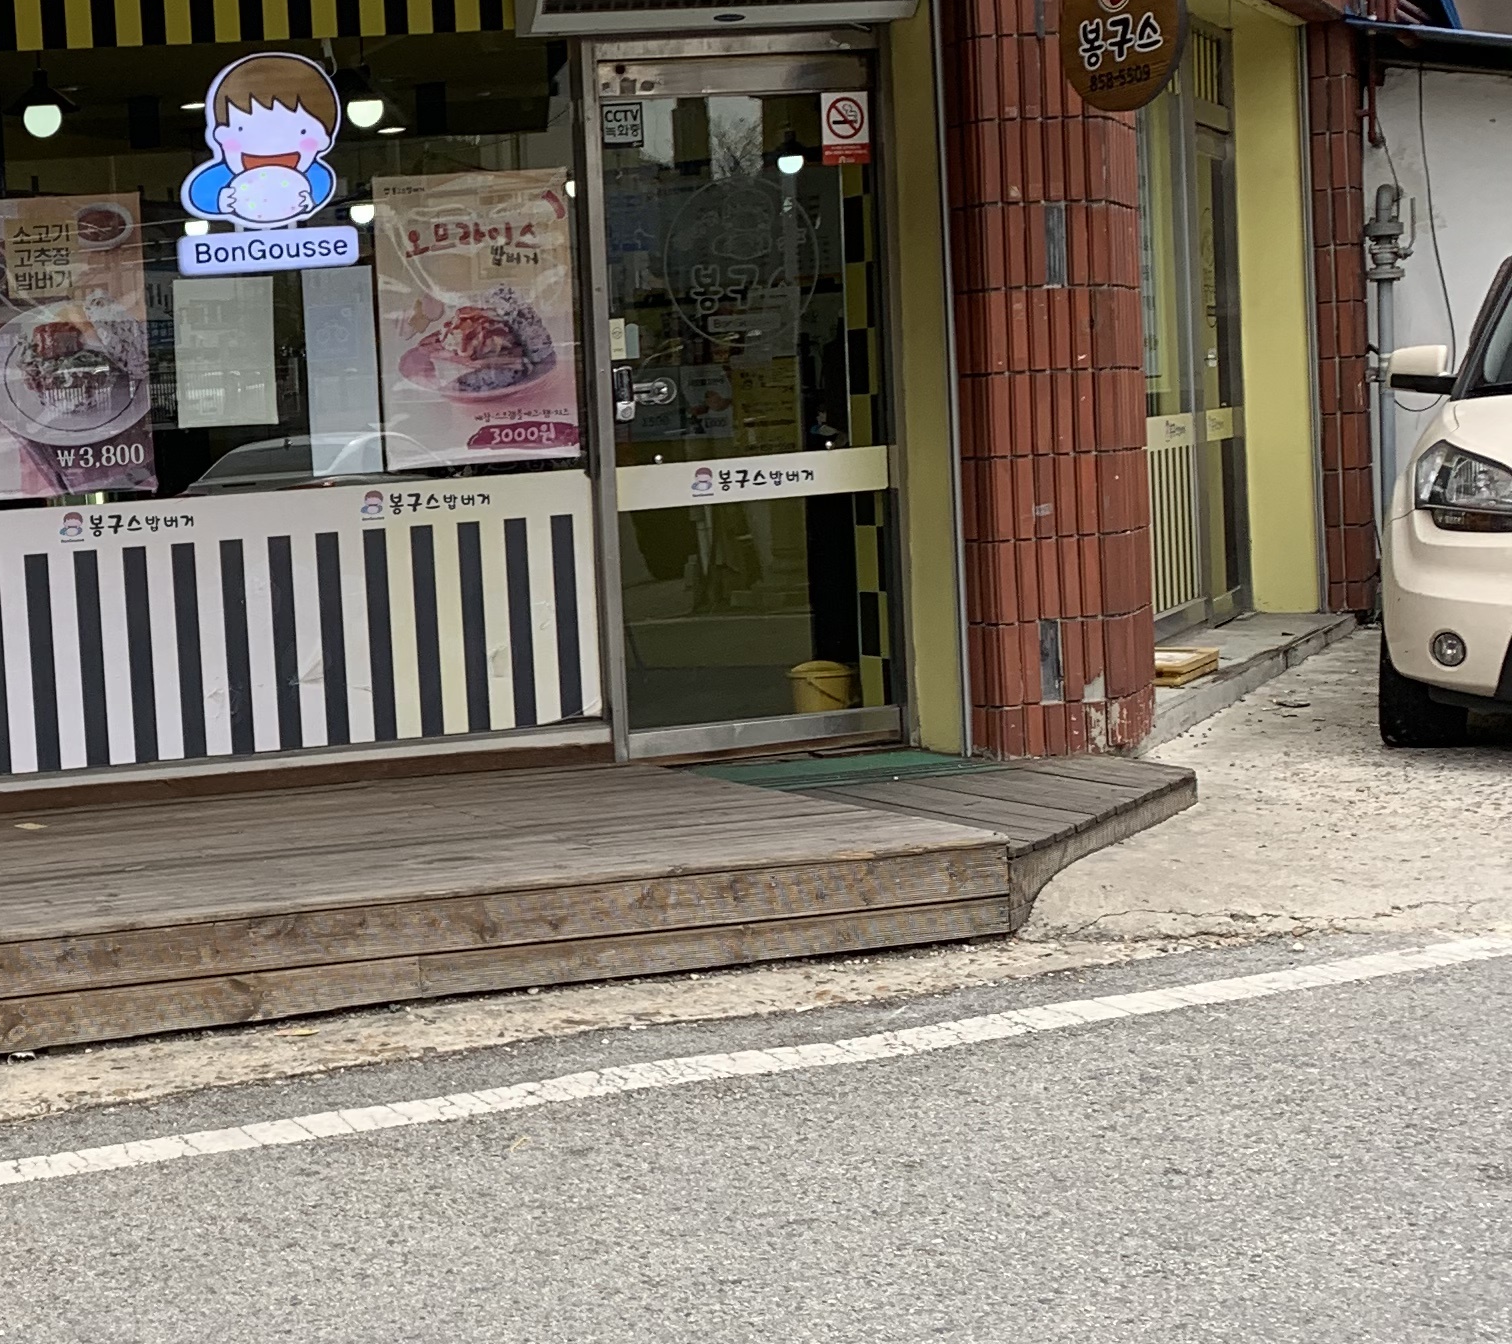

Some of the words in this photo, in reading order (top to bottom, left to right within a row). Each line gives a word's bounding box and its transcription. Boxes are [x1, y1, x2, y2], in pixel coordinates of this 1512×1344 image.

[1078, 11, 1164, 71] 봉구스
[1089, 63, 1151, 92] 858-5509
[604, 109, 640, 123] CCTV
[12, 223, 71, 245] 소고기
[13, 246, 71, 268] 고추장
[194, 238, 348, 265] BonGousse
[14, 269, 73, 291] 밥버거
[489, 422, 556, 445] 3000원
[718, 469, 815, 491] 봉구스밥버거
[389, 493, 491, 516] 봉구스밥버거
[89, 513, 195, 538] 봉구스밥버거
